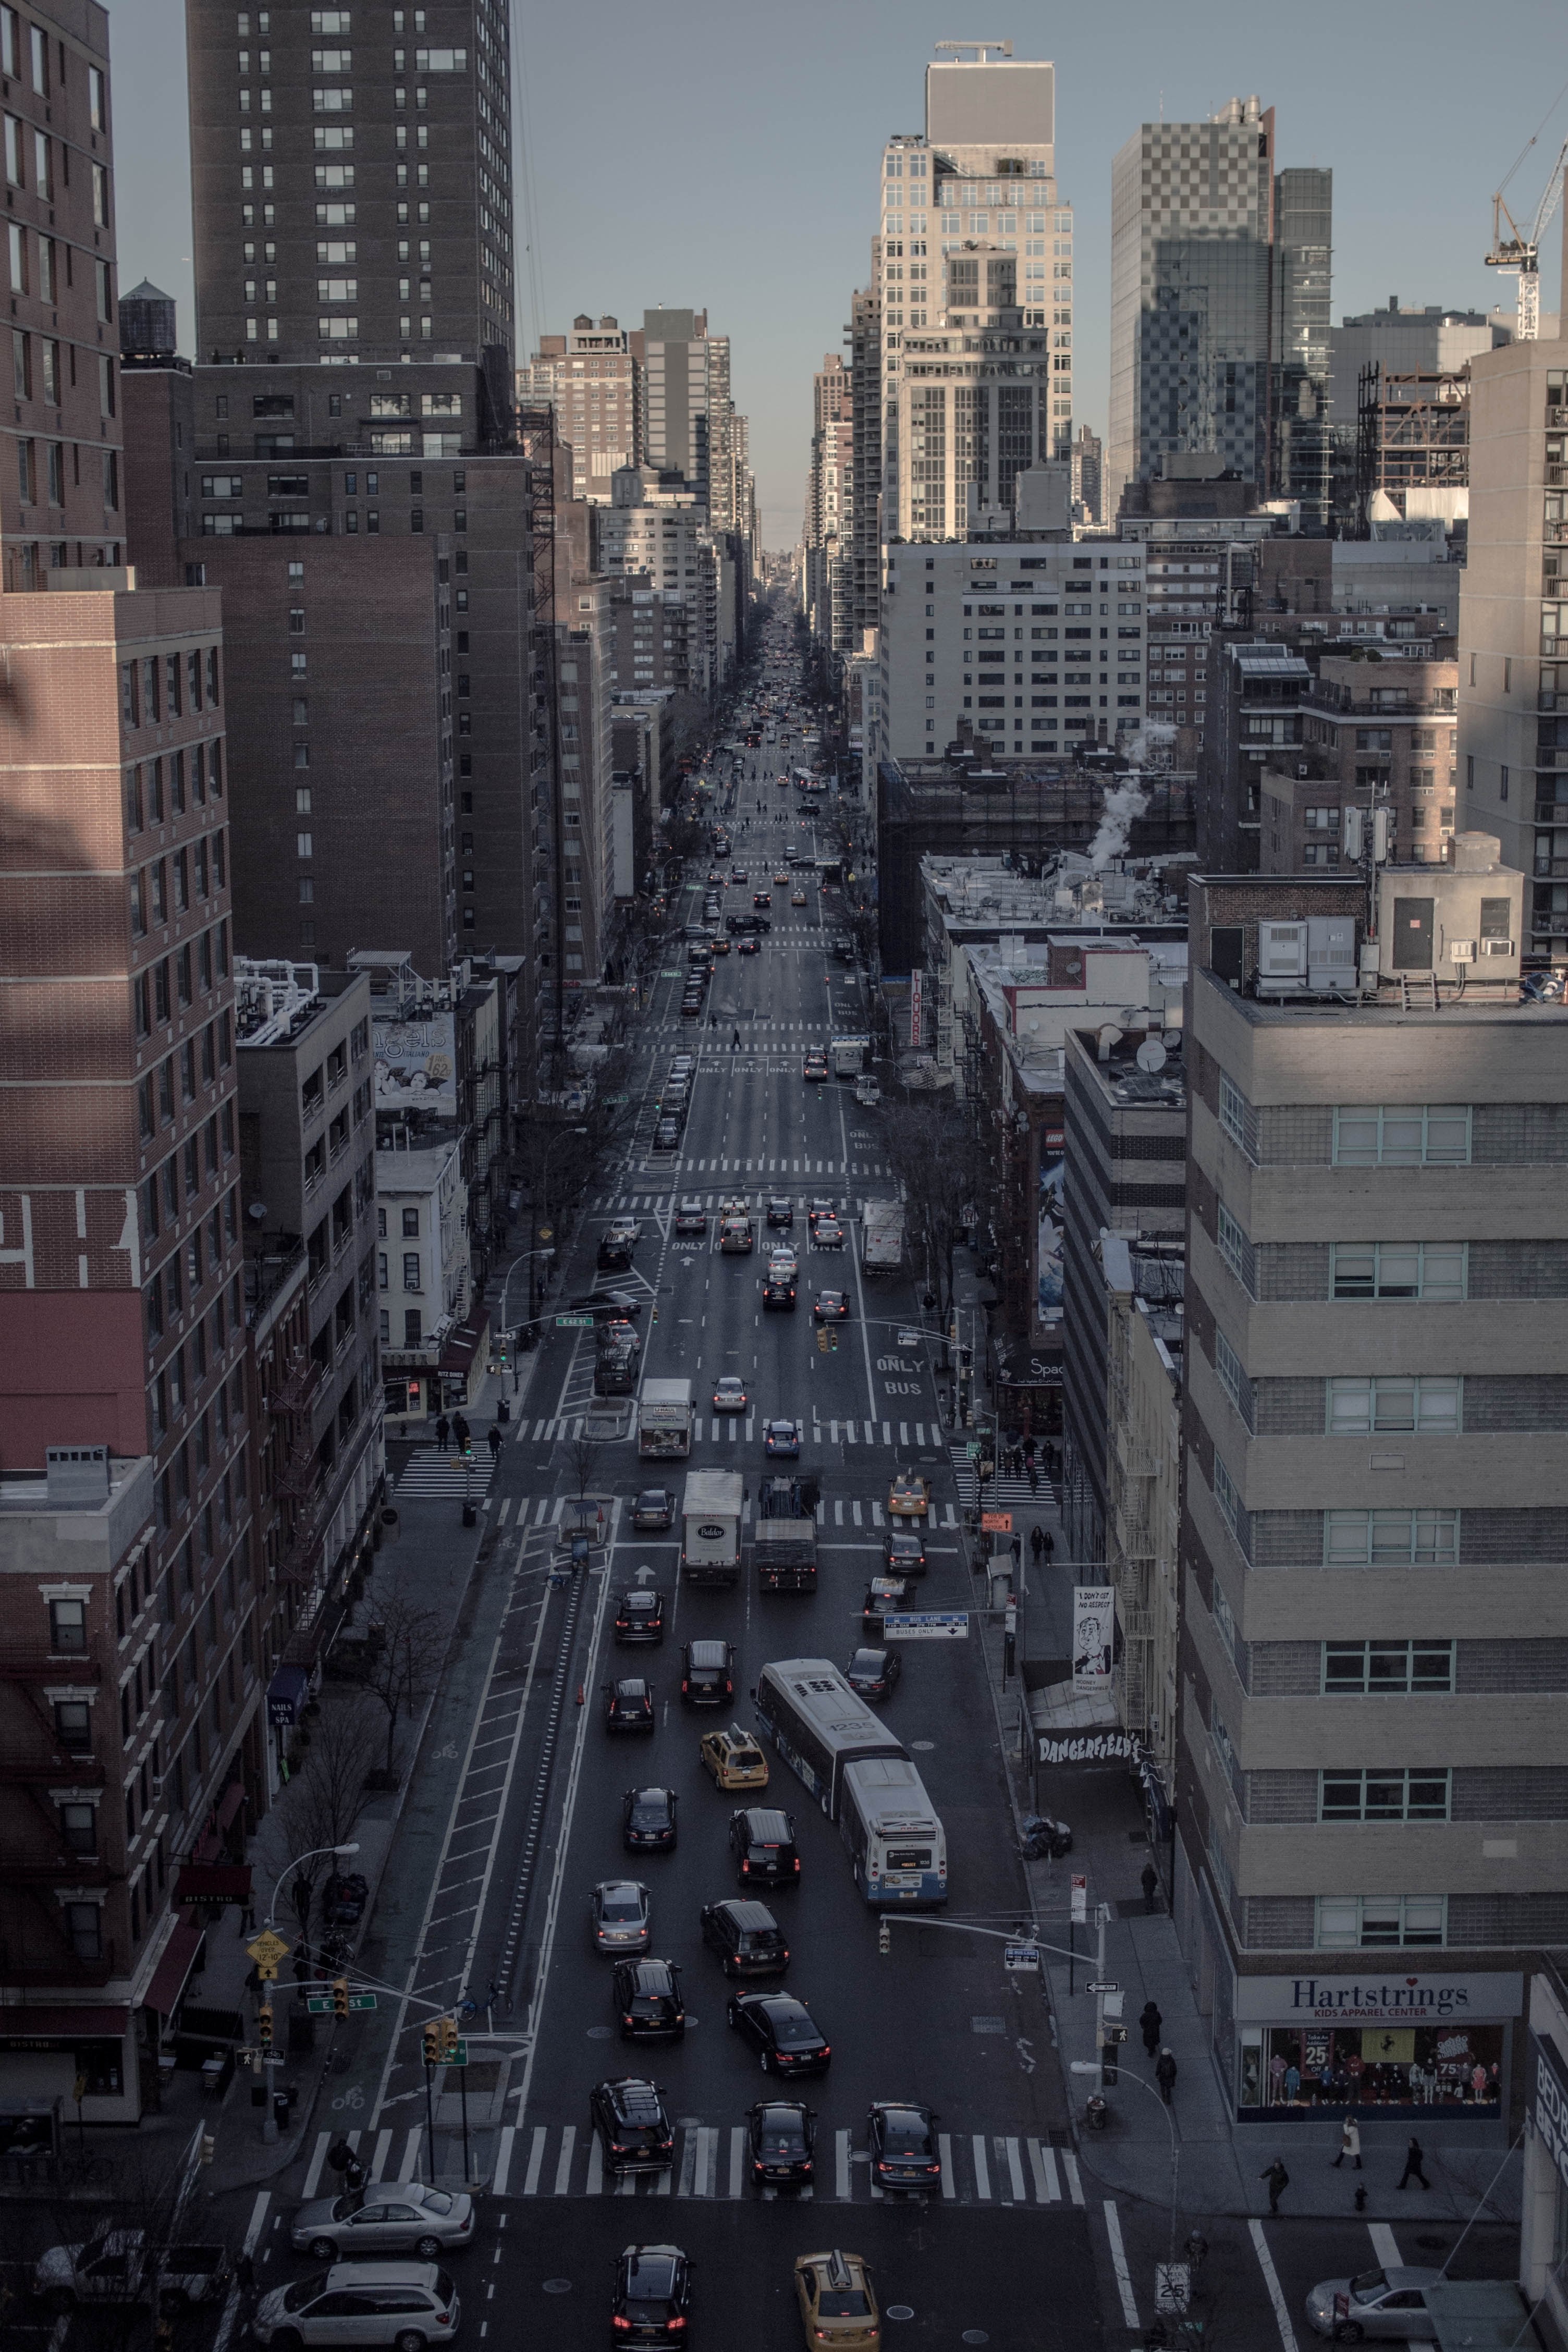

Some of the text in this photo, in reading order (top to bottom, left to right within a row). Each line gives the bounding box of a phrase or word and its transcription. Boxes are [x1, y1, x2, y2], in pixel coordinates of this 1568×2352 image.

[1046, 1134, 1063, 1143] LEGO
[877, 1358, 925, 1373] ONLY
[885, 1381, 922, 1395] BUS
[701, 1527, 724, 1536] Baldor
[830, 1722, 875, 1731] 1235
[323, 1998, 361, 2009] E St
[1291, 1981, 1467, 2015] Hartstrings
[1341, 2008, 1385, 2017] APPAREL
[1388, 2008, 1427, 2016] CENTER
[1538, 2054, 1560, 2123] BED
[1161, 2284, 1184, 2297] 25
